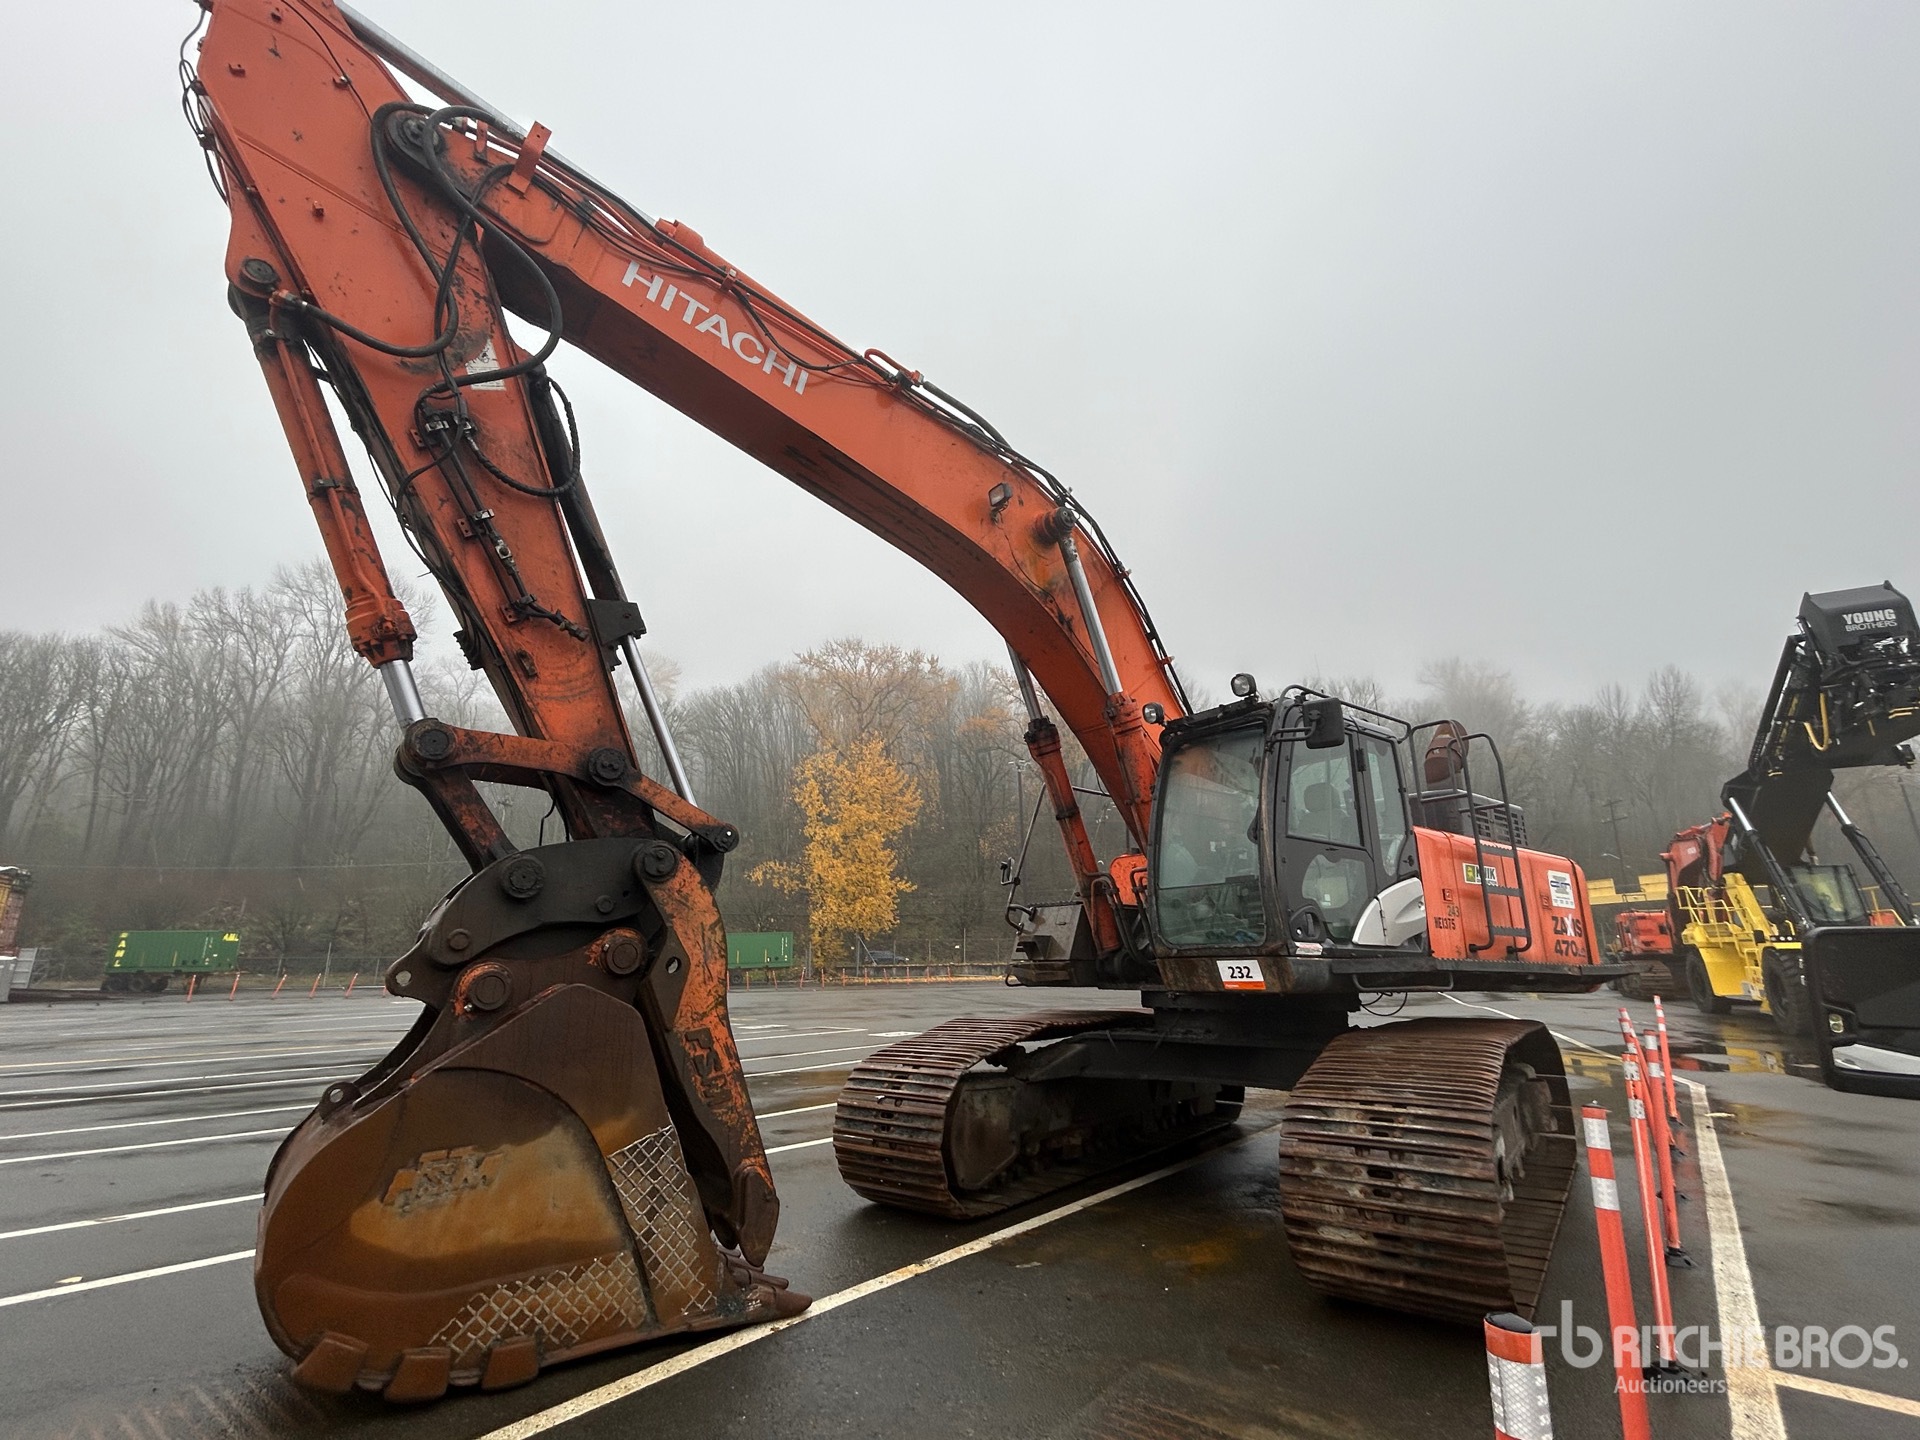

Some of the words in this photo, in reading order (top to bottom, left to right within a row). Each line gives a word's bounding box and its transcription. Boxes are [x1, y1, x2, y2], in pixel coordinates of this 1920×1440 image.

[621, 260, 809, 396] HITACHI
[1842, 608, 1897, 625] YOUNG
[1845, 620, 1898, 632] BROTHERS
[1552, 913, 1583, 938] ZAXIS
[1554, 939, 1578, 957] 470
[1228, 966, 1253, 979] 232
